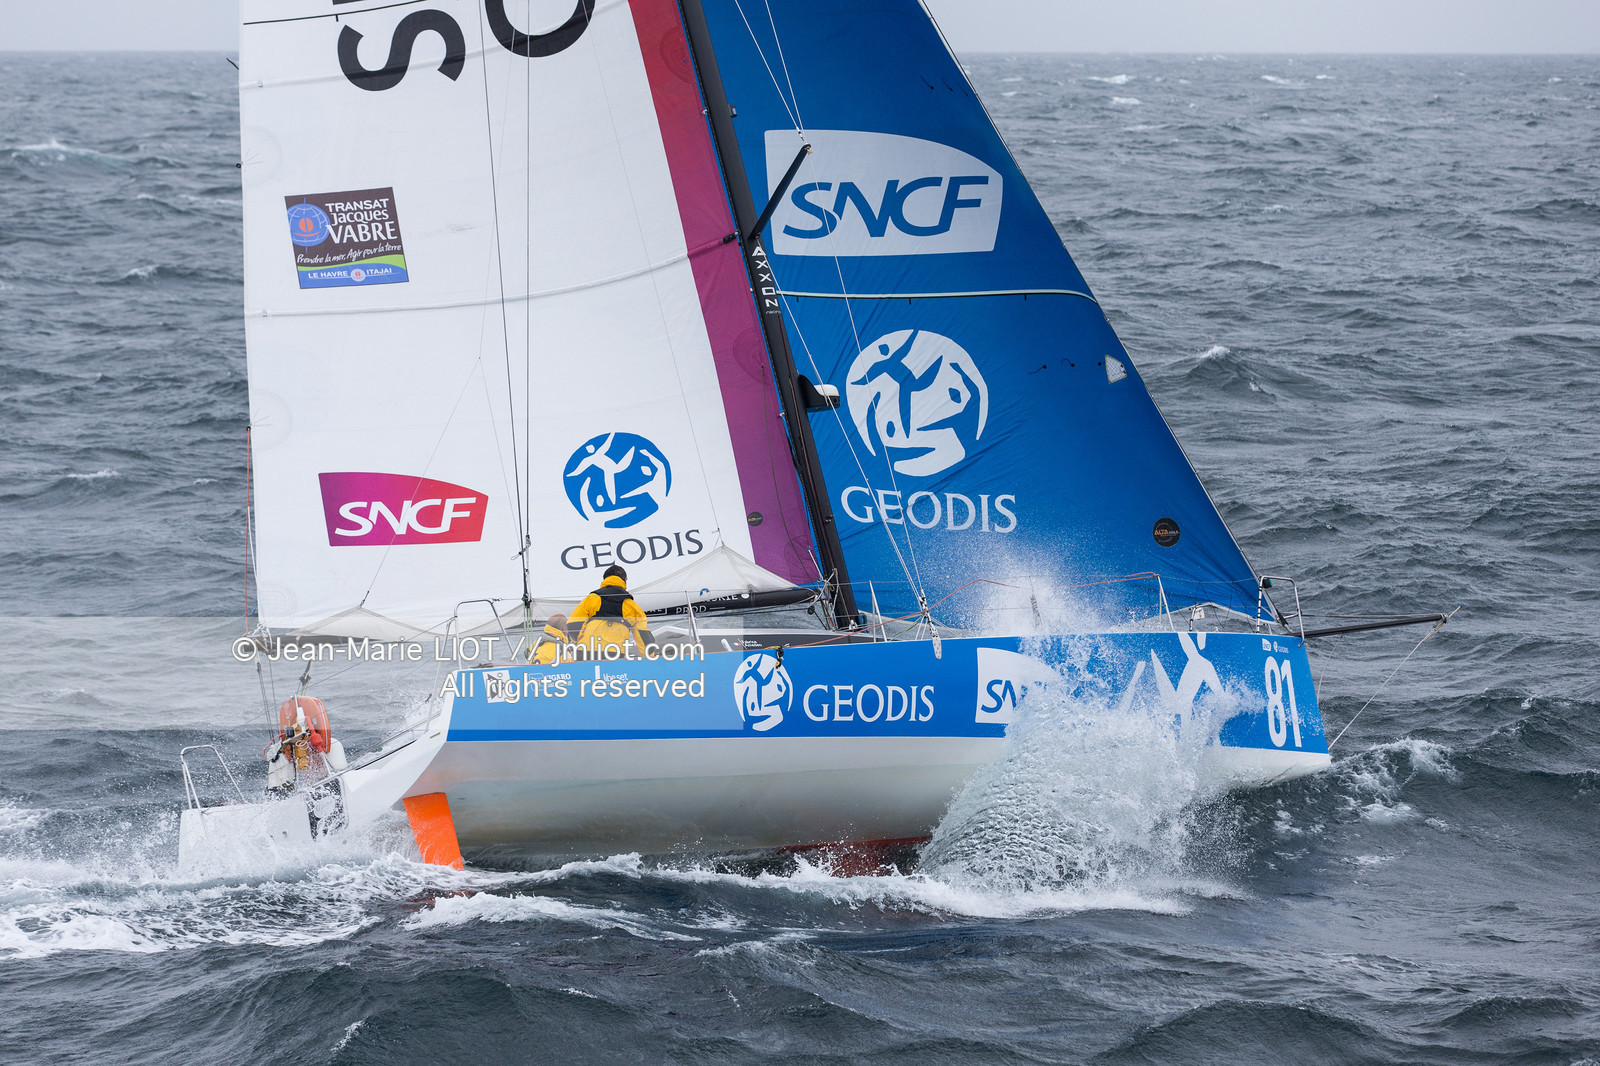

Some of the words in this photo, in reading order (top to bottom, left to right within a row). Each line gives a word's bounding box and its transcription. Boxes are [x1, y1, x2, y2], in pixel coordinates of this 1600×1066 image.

[325, 198, 389, 212] TRANSAT
[783, 176, 989, 239] SNCF
[326, 221, 398, 244] VABRE
[297, 253, 323, 264] Prendre
[324, 252, 331, 263] la
[347, 248, 363, 262] Agir
[363, 246, 378, 258] pour
[378, 242, 385, 252] la
[385, 242, 402, 252] terre
[320, 270, 348, 278] HAVRE
[751, 246, 779, 308] AXXON
[334, 496, 477, 536] SNCF
[841, 486, 1017, 533] GEODIS
[560, 529, 704, 571] GEODIS
[803, 684, 935, 723] GEODIS
[1265, 656, 1302, 747] 81
